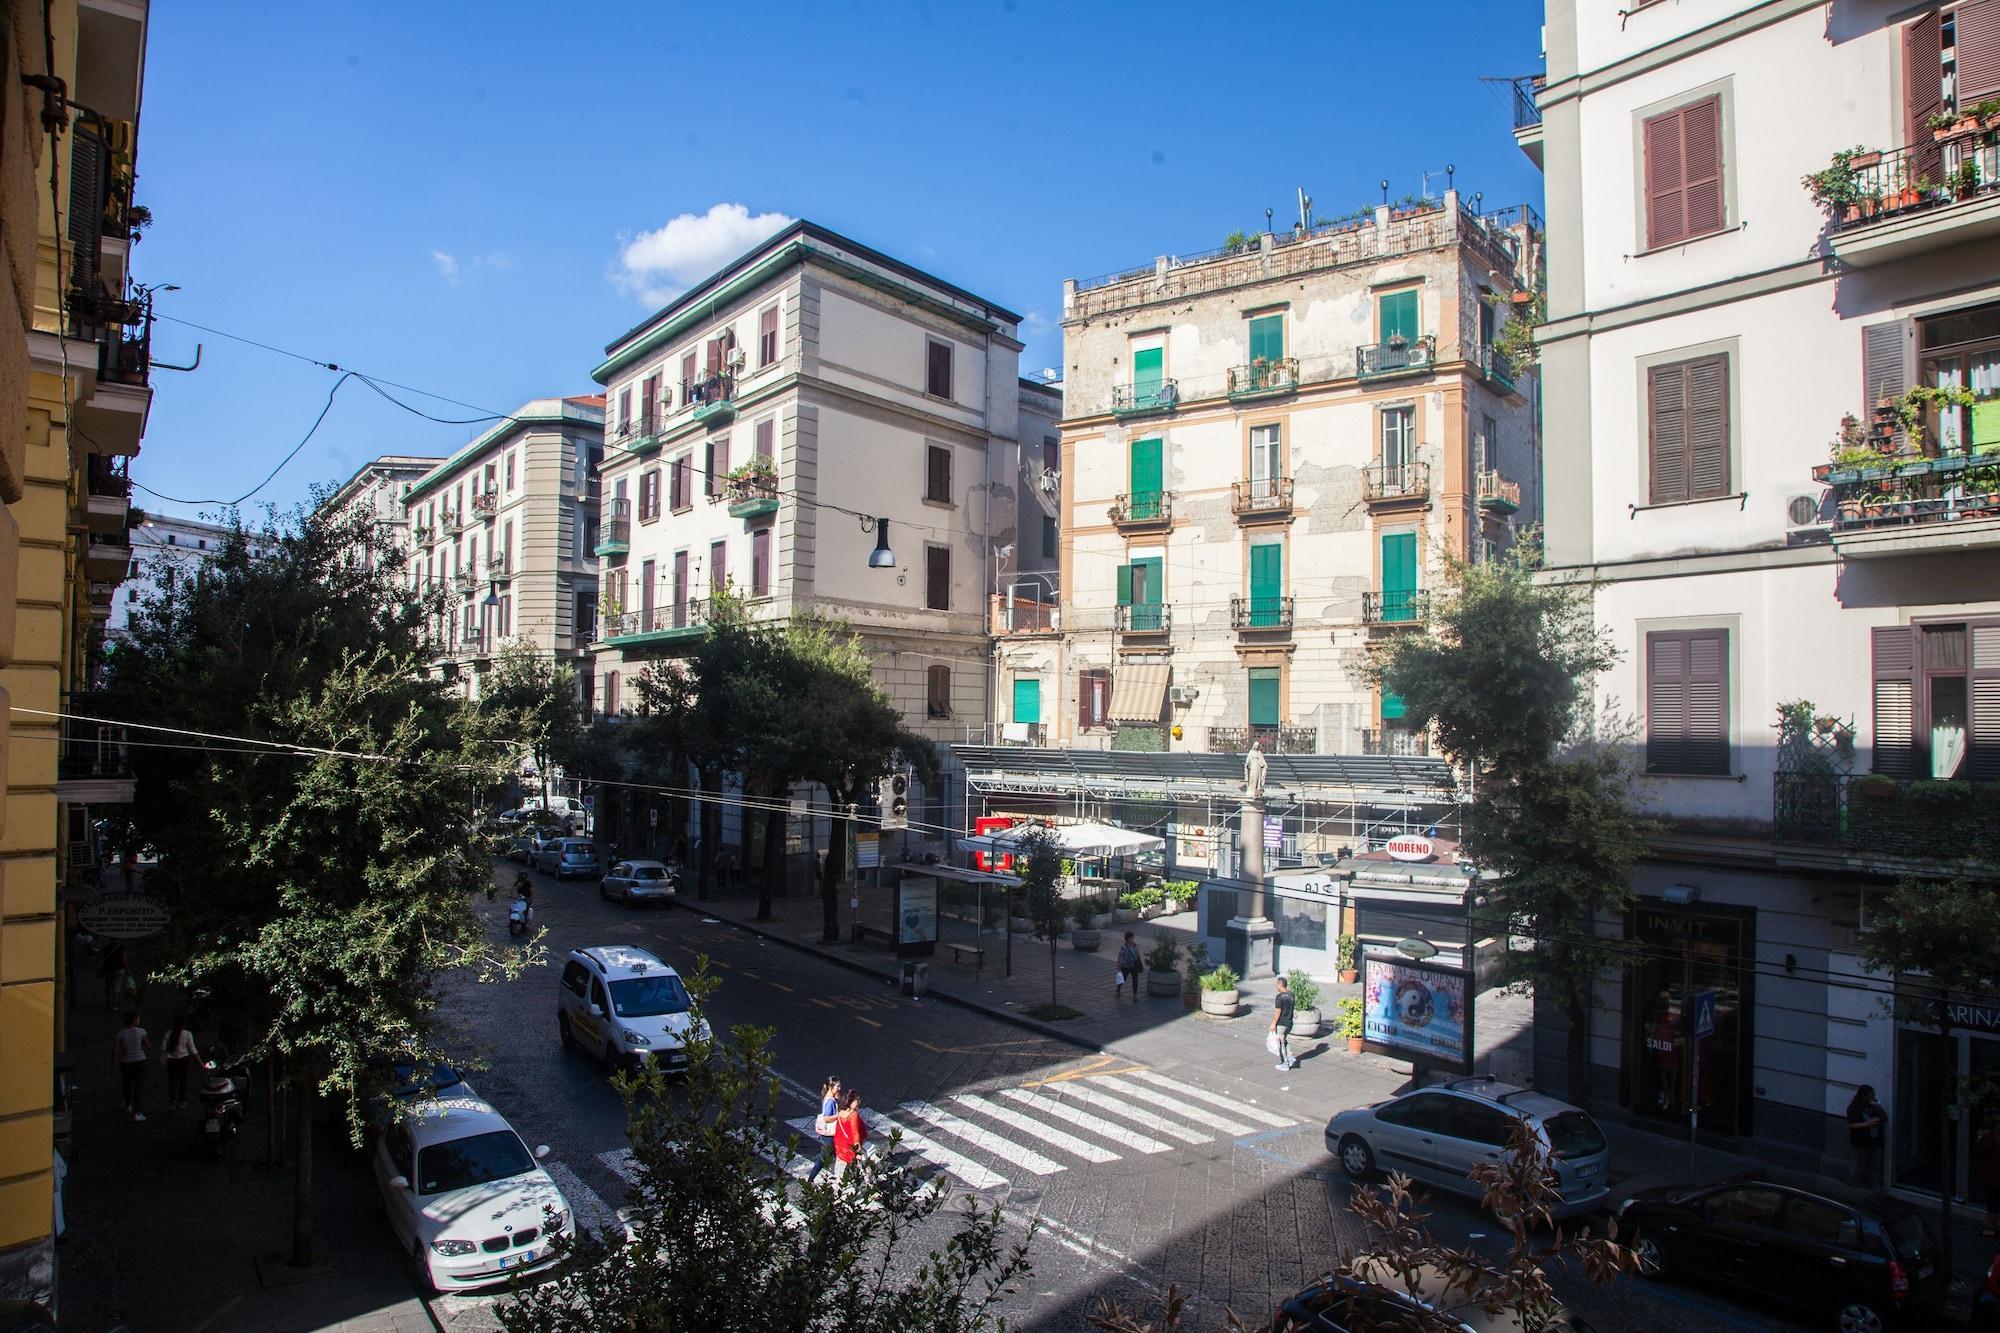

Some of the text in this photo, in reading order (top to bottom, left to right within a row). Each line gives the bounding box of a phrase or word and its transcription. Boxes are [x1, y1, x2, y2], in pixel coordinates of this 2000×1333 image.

[1388, 842, 1430, 855] MORENO
[1368, 962, 1408, 977] FESTIVAL
[1646, 1038, 1672, 1052] SALDI
